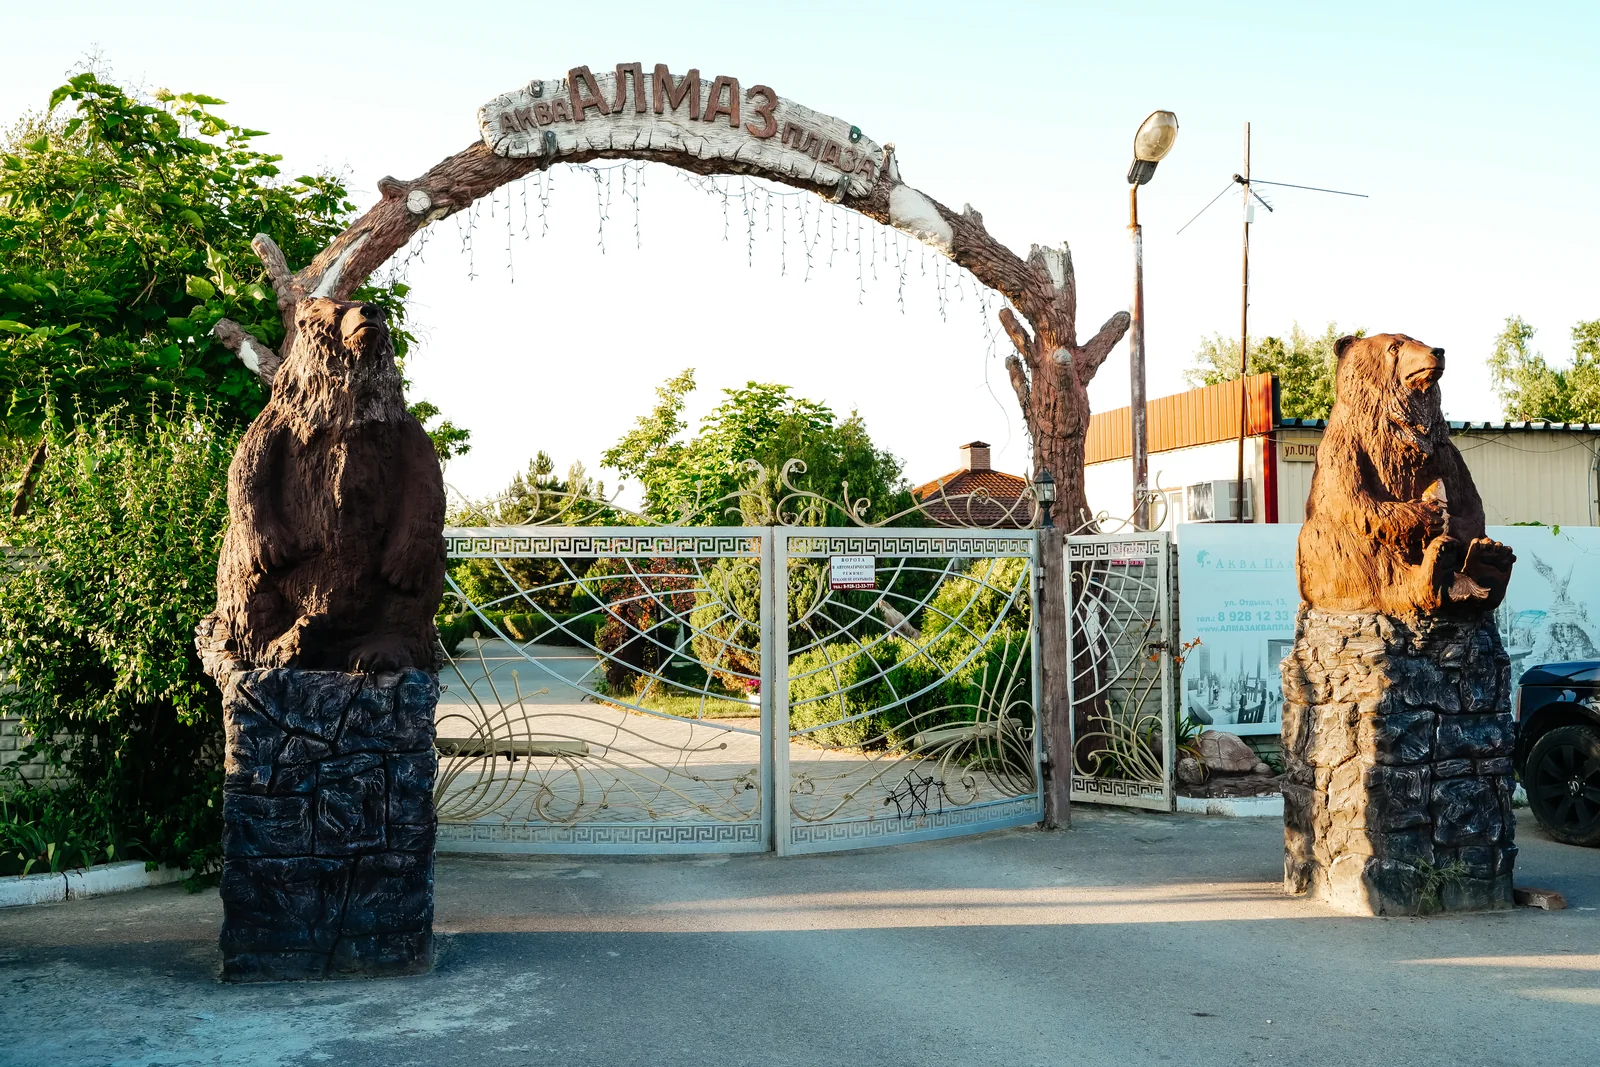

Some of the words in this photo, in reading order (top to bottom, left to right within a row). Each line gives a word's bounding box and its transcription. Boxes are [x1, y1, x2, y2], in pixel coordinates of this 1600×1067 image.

[501, 98, 573, 134] АКВА
[568, 62, 779, 139] АЛМАЗ
[781, 121, 875, 180] ПЛАЗА
[1224, 600, 1237, 608] ул.
[1239, 598, 1273, 607] Отдыха,
[1275, 598, 1288, 607] 13,
[1218, 612, 1225, 622] 8
[1229, 611, 1252, 622] 928
[1256, 610, 1271, 621] 12
[1274, 610, 1289, 621] 33
[1196, 623, 1295, 632] www.АЛМАЗАКВАПЛАЗ
